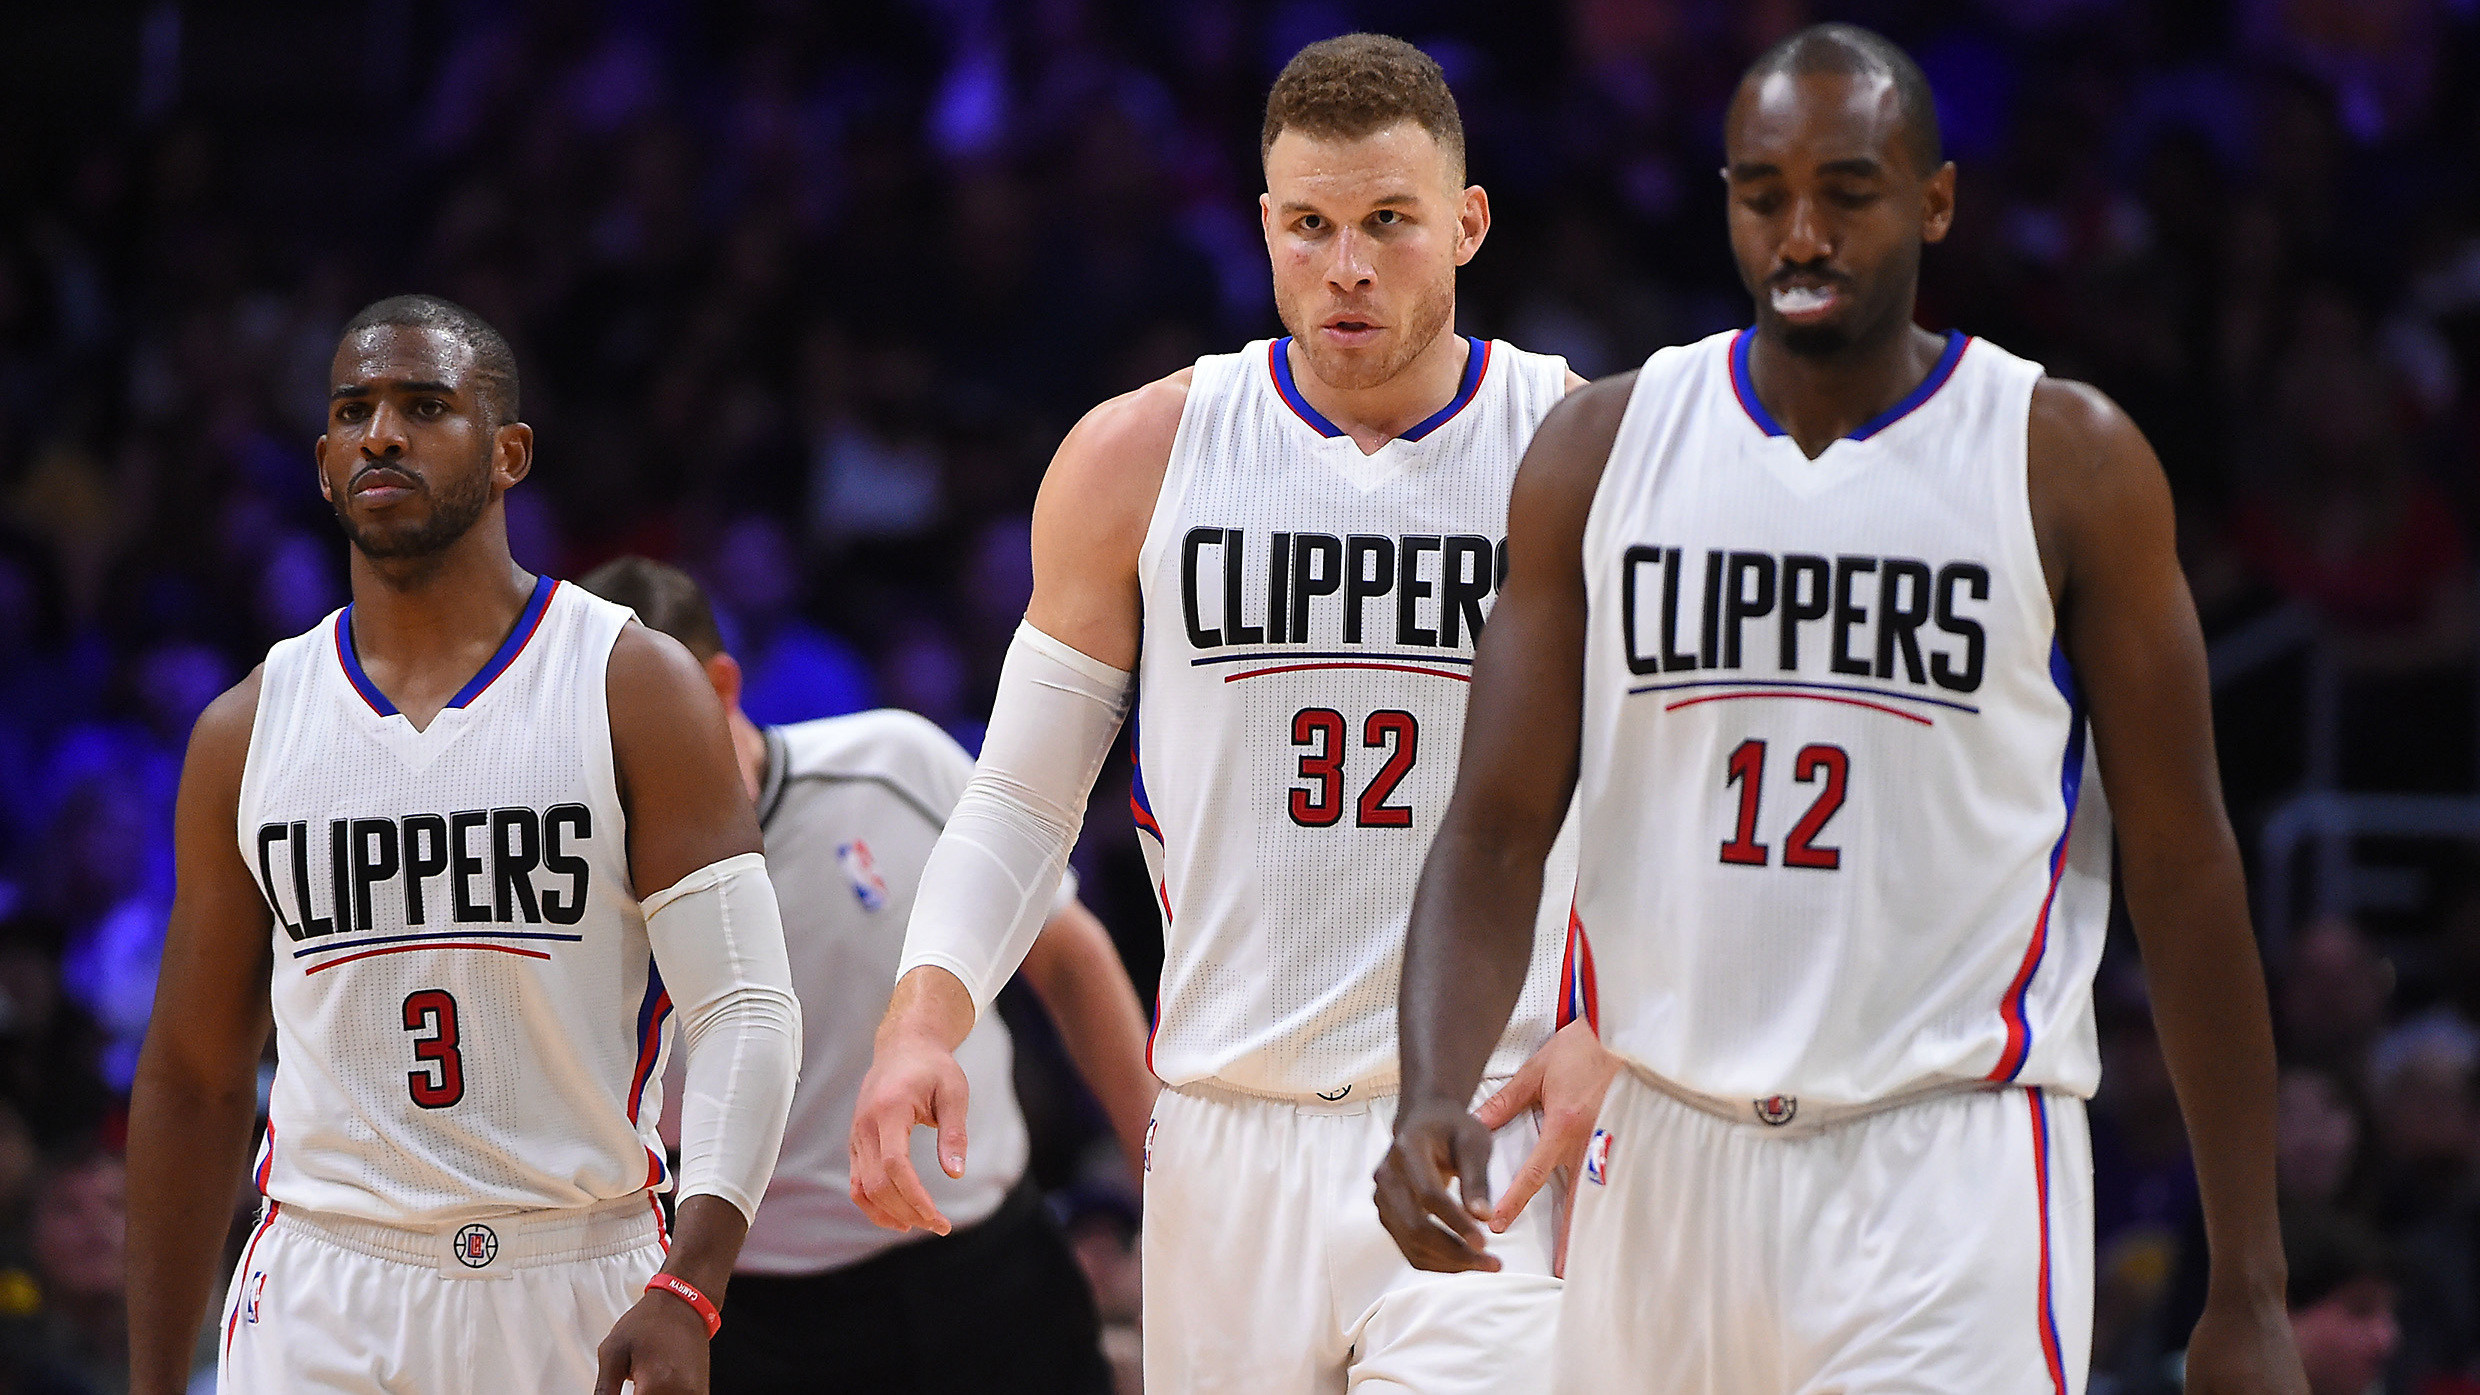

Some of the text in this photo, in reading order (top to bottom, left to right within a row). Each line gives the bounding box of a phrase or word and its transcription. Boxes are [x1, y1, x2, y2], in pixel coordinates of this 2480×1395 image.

[1622, 544, 1990, 693] CLIPPERS
[1288, 707, 1419, 828] 32
[1719, 738, 1849, 869] 12
[257, 802, 592, 942] CLIPPERS
[402, 988, 465, 1109] 3
[669, 1279, 698, 1301] CAMRYN
